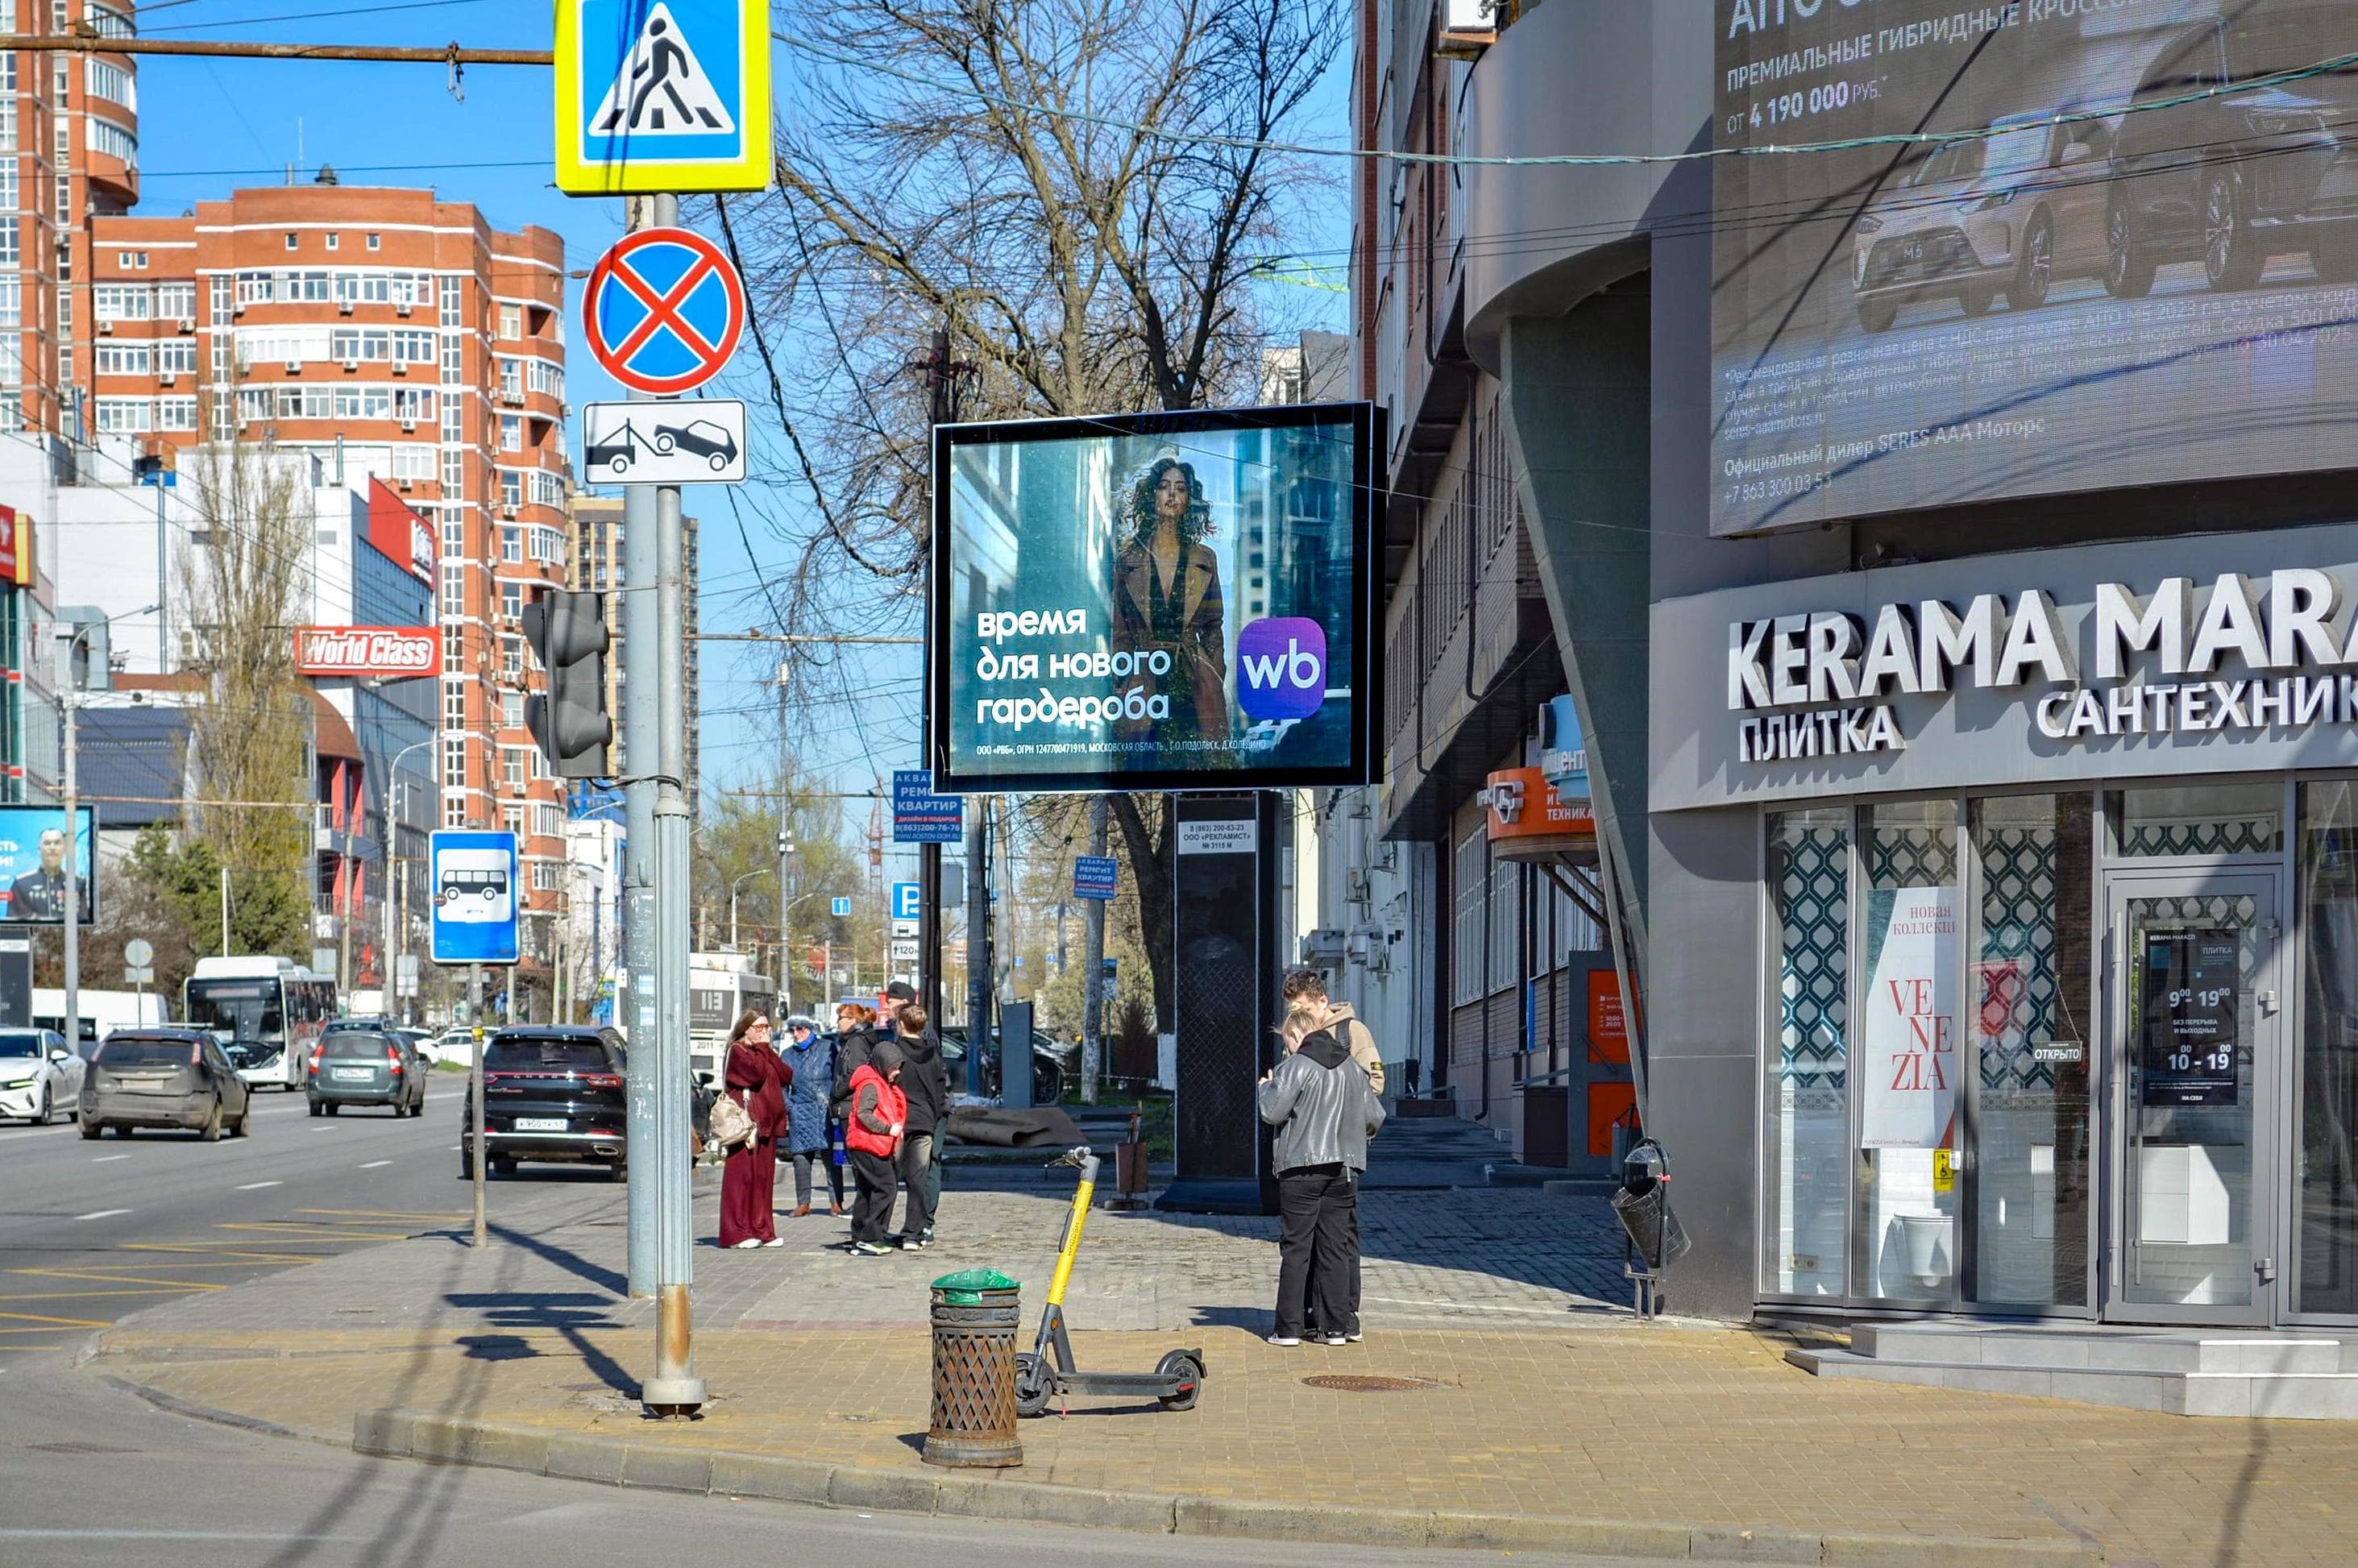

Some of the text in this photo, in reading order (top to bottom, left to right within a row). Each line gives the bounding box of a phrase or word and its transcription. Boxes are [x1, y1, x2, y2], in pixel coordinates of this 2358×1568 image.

[1728, 34, 1872, 91] ПРЕМИАЛЬНЫЕ
[1879, 2, 2020, 53] ГИБРИДНЫЕ
[1750, 102, 1762, 128] 4
[1767, 92, 1804, 123] 190
[1809, 81, 1849, 114] 000
[1725, 444, 1822, 479] Официальный
[1827, 441, 1874, 463] дилер
[1879, 429, 1929, 451] SERES
[1978, 418, 2045, 439] Моторс
[1743, 482, 1765, 501] 863
[1769, 478, 1791, 497] 300
[978, 608, 1086, 645] время
[1728, 568, 2358, 710] KERAMA MAR
[369, 636, 429, 666] Class
[977, 646, 1171, 681] для нового
[1242, 639, 1321, 689] wb
[978, 685, 1169, 732] гардероба
[977, 745, 991, 755] ООО
[1017, 744, 1034, 753] ОГРН
[1089, 741, 1132, 753] МОСКОВСКАЯ
[1739, 705, 1906, 762] ПЛИТКА
[897, 801, 957, 811] КВАРТИР
[1546, 807, 1595, 821] ТЕХНИКА
[1202, 832, 1251, 840] «РЕКЛАМИСТ»
[1910, 905, 1951, 919] новая
[2202, 946, 2232, 955] ПЛИТКА
[1888, 979, 1932, 1016] VE
[1908, 1016, 1953, 1053] NE
[1891, 1054, 1947, 1090] ZIA
[2034, 1048, 2080, 1060] ОТКРЫТО
